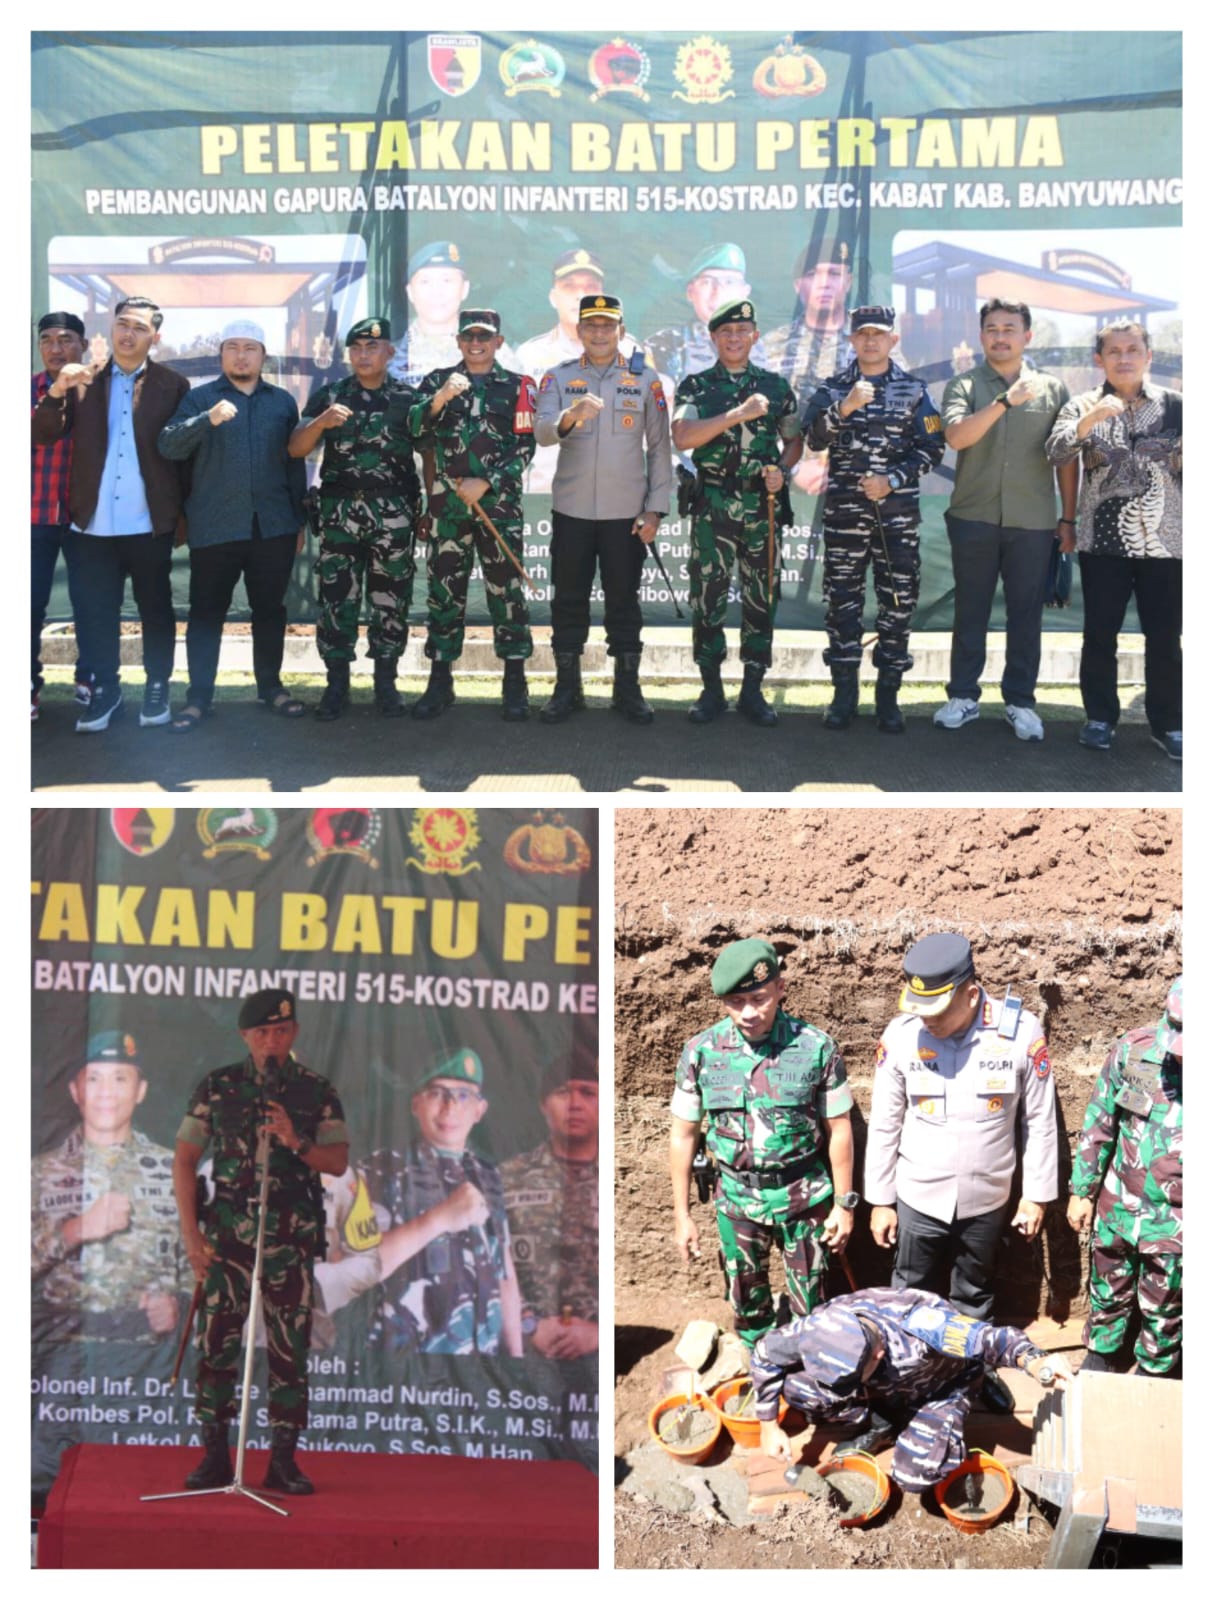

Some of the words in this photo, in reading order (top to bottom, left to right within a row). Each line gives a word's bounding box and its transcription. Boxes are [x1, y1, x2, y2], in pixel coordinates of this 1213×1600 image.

[201, 119, 553, 175] PELETAKAN
[570, 118, 736, 173] BATU
[755, 114, 1065, 170] PERTAMA
[86, 187, 267, 215] PEMBANGUNAN
[274, 187, 369, 213] GAPURA
[374, 184, 497, 212] BATALYON
[504, 184, 629, 212] INFANTERI
[635, 183, 799, 212] 515-KOSTRAD
[807, 183, 861, 210] KEC.
[869, 180, 948, 208] KABAT
[954, 182, 1012, 209] KAB.
[1018, 177, 1183, 208] BANYUWANG
[31, 880, 256, 949] AKAN
[280, 891, 479, 960] BATU
[502, 902, 592, 966] PE
[34, 959, 185, 996] BATALYON
[194, 967, 347, 1002] INFANTERI
[354, 972, 550, 1011] 515-KOSTRAD
[557, 983, 598, 1014] KE
[909, 1060, 941, 1073] RAMA
[979, 1060, 1014, 1072] POLRI
[103, 1376, 137, 1396] Inf.
[145, 1377, 174, 1398] Dr.
[400, 1384, 479, 1410] Nurdin,
[486, 1388, 562, 1415] S.Sos.,
[38, 1401, 130, 1424] Kombes
[137, 1404, 179, 1425] Pol.
[365, 1411, 429, 1435] Putra,
[435, 1413, 498, 1438] S.I.K.,
[505, 1416, 564, 1441] M.Si.,
